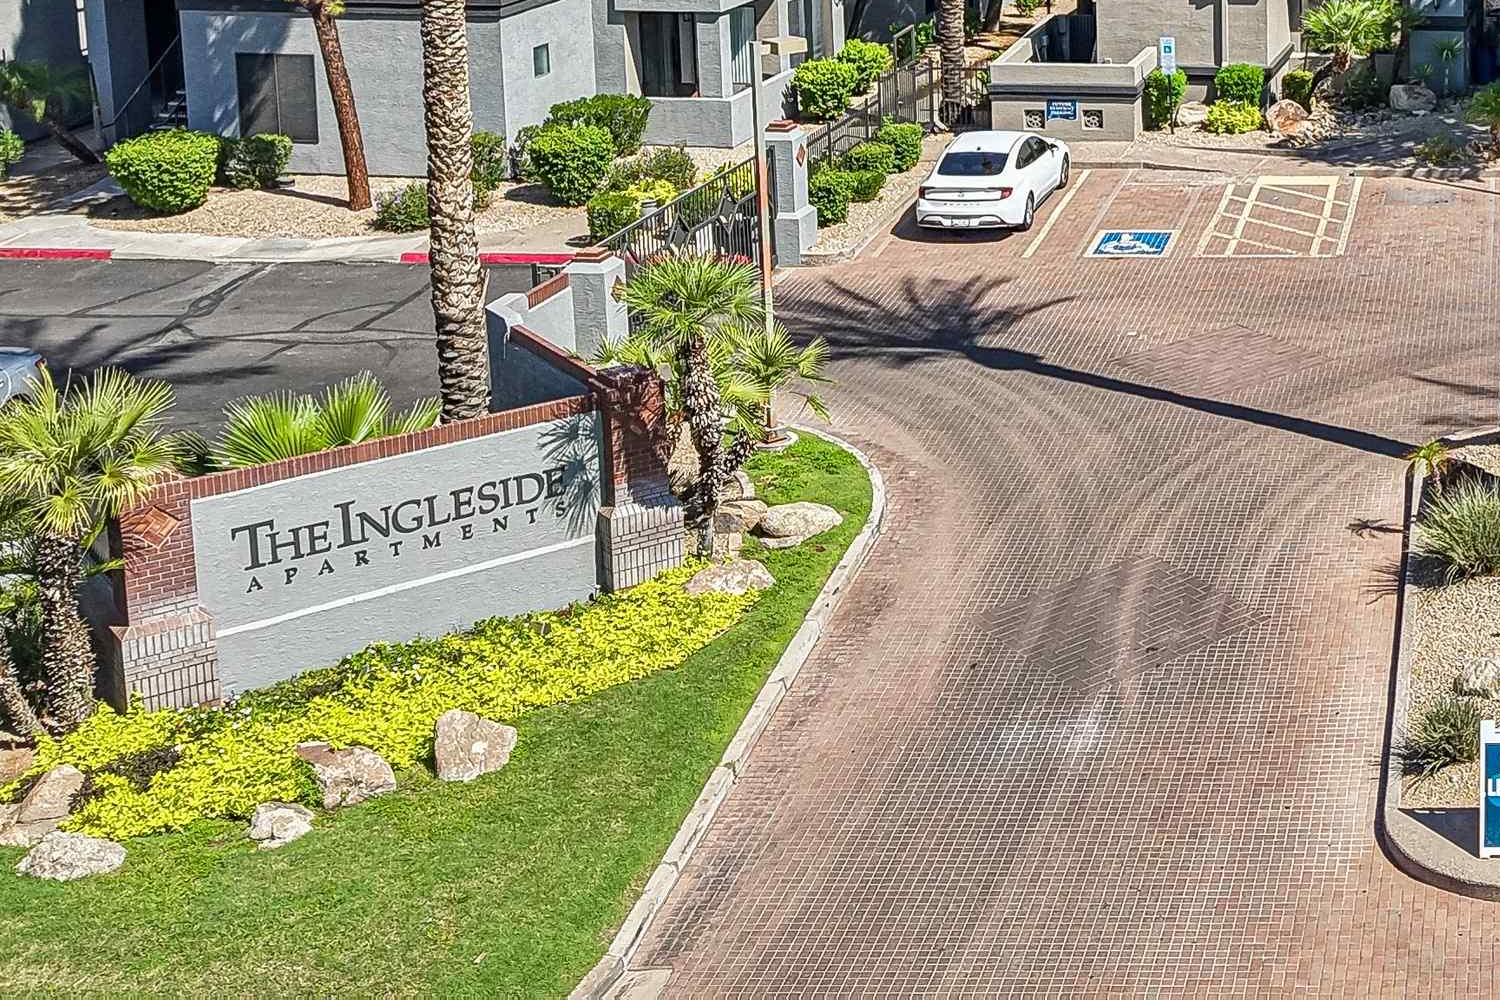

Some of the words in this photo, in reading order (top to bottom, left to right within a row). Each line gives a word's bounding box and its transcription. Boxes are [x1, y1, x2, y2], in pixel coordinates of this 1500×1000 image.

[231, 519, 333, 571] THE
[335, 465, 568, 549] INGLESIDE
[246, 504, 569, 593] APARTMENTS
